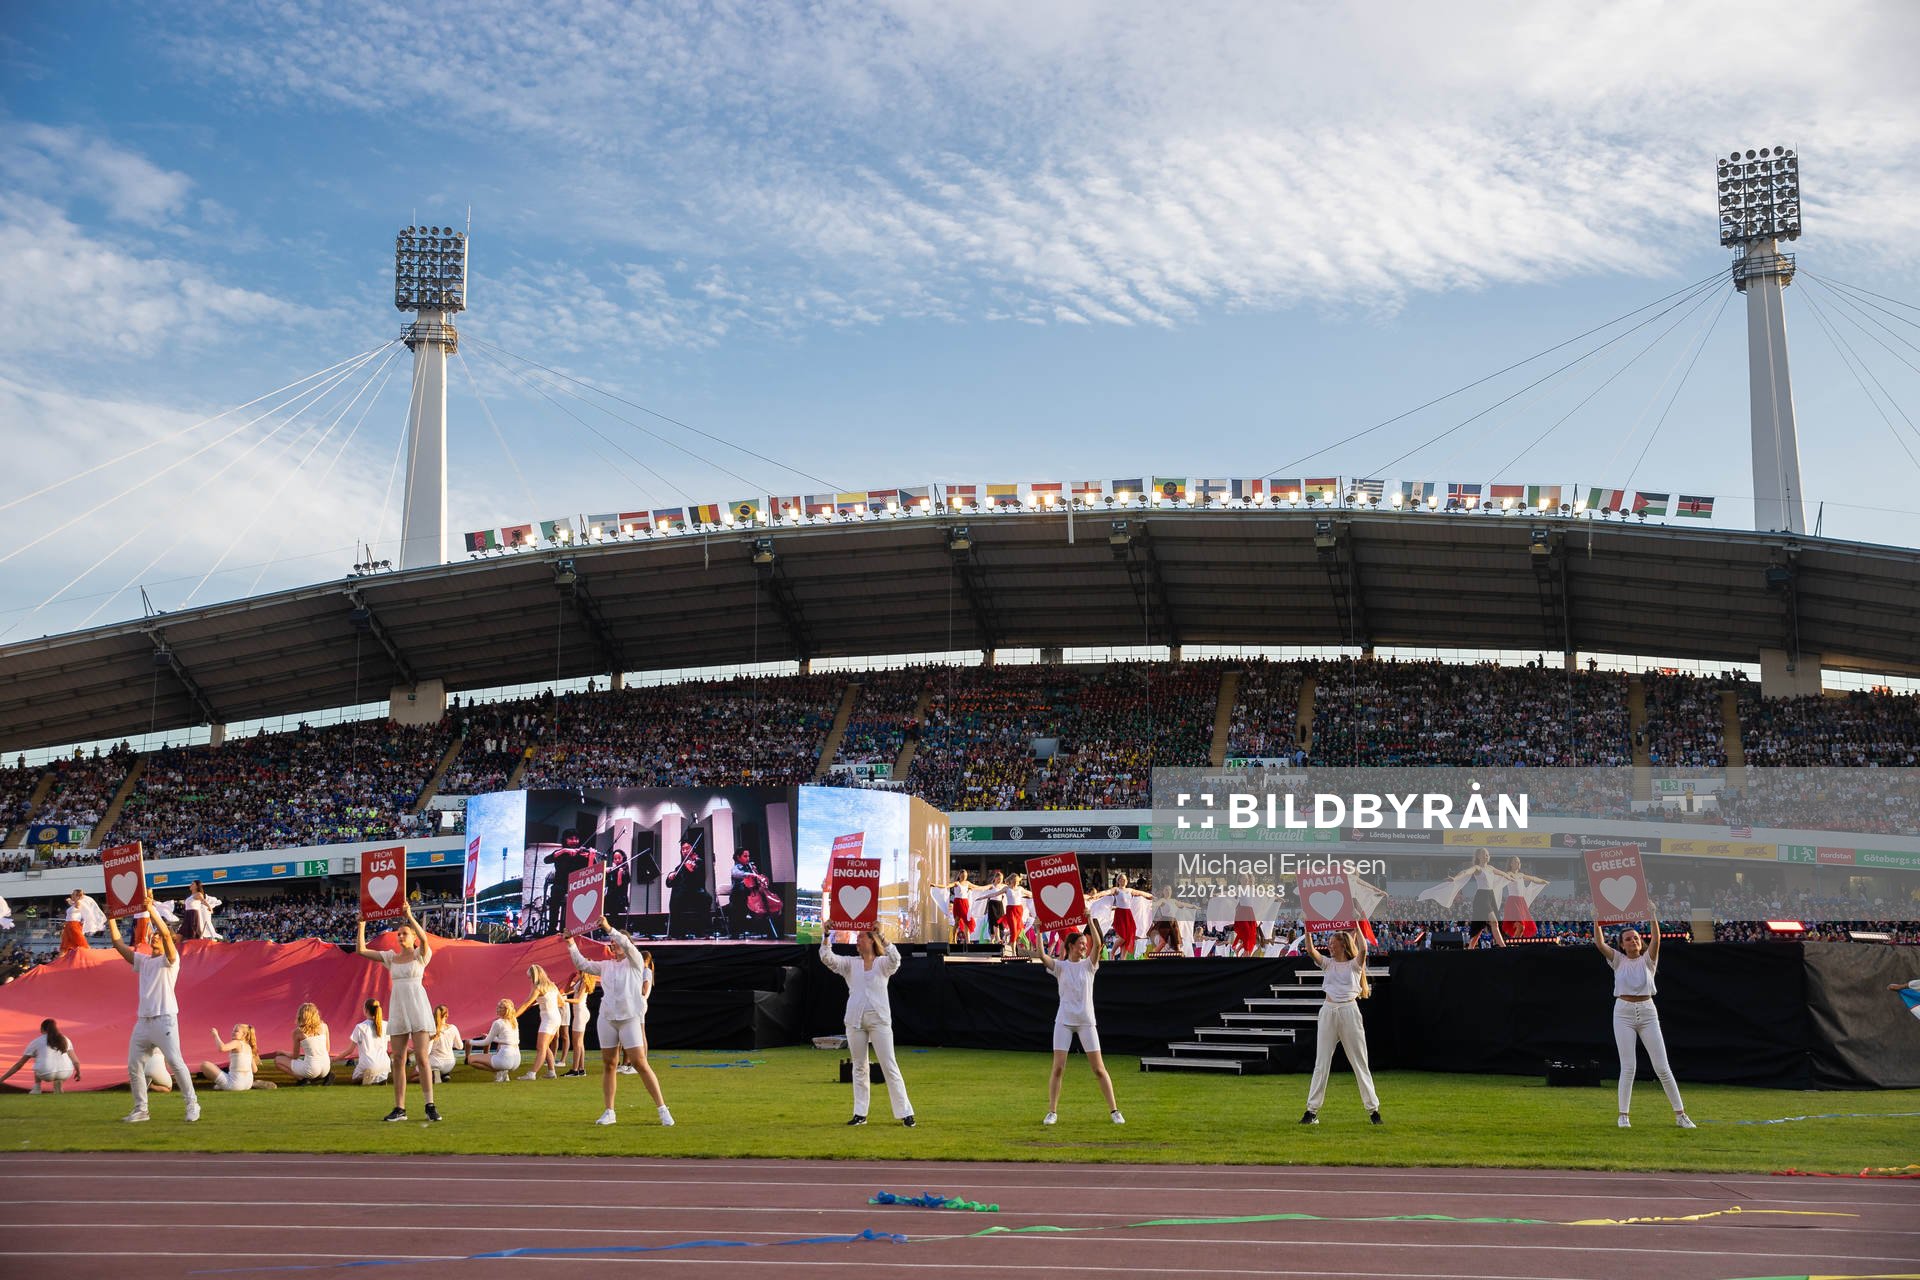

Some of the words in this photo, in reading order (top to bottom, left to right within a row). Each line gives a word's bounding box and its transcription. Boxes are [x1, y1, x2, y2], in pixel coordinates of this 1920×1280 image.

[1171, 828, 1220, 841] Picadeli
[1256, 828, 1304, 842] Picadeli
[113, 847, 130, 857] FROM
[374, 851, 393, 859] FROM
[1600, 849, 1623, 858] FROM
[1820, 852, 1852, 860] nordstan
[104, 853, 141, 869] GERMANY
[1040, 857, 1063, 867] FROM
[1591, 857, 1637, 872] GREECE
[1863, 854, 1910, 865] Göteborgs
[370, 859, 396, 873] USA
[1029, 863, 1078, 879] COLOMBIA
[579, 868, 595, 877] FROM
[833, 868, 880, 878] ENGLAND
[569, 872, 604, 891] ICELAND
[1302, 875, 1345, 888] MALTA
[384, 908, 400, 917] LOVE
[1603, 914, 1623, 922] WITH
[1625, 911, 1644, 919] LOVE
[1044, 920, 1064, 929] WITH
[1065, 916, 1082, 926] LOVE
